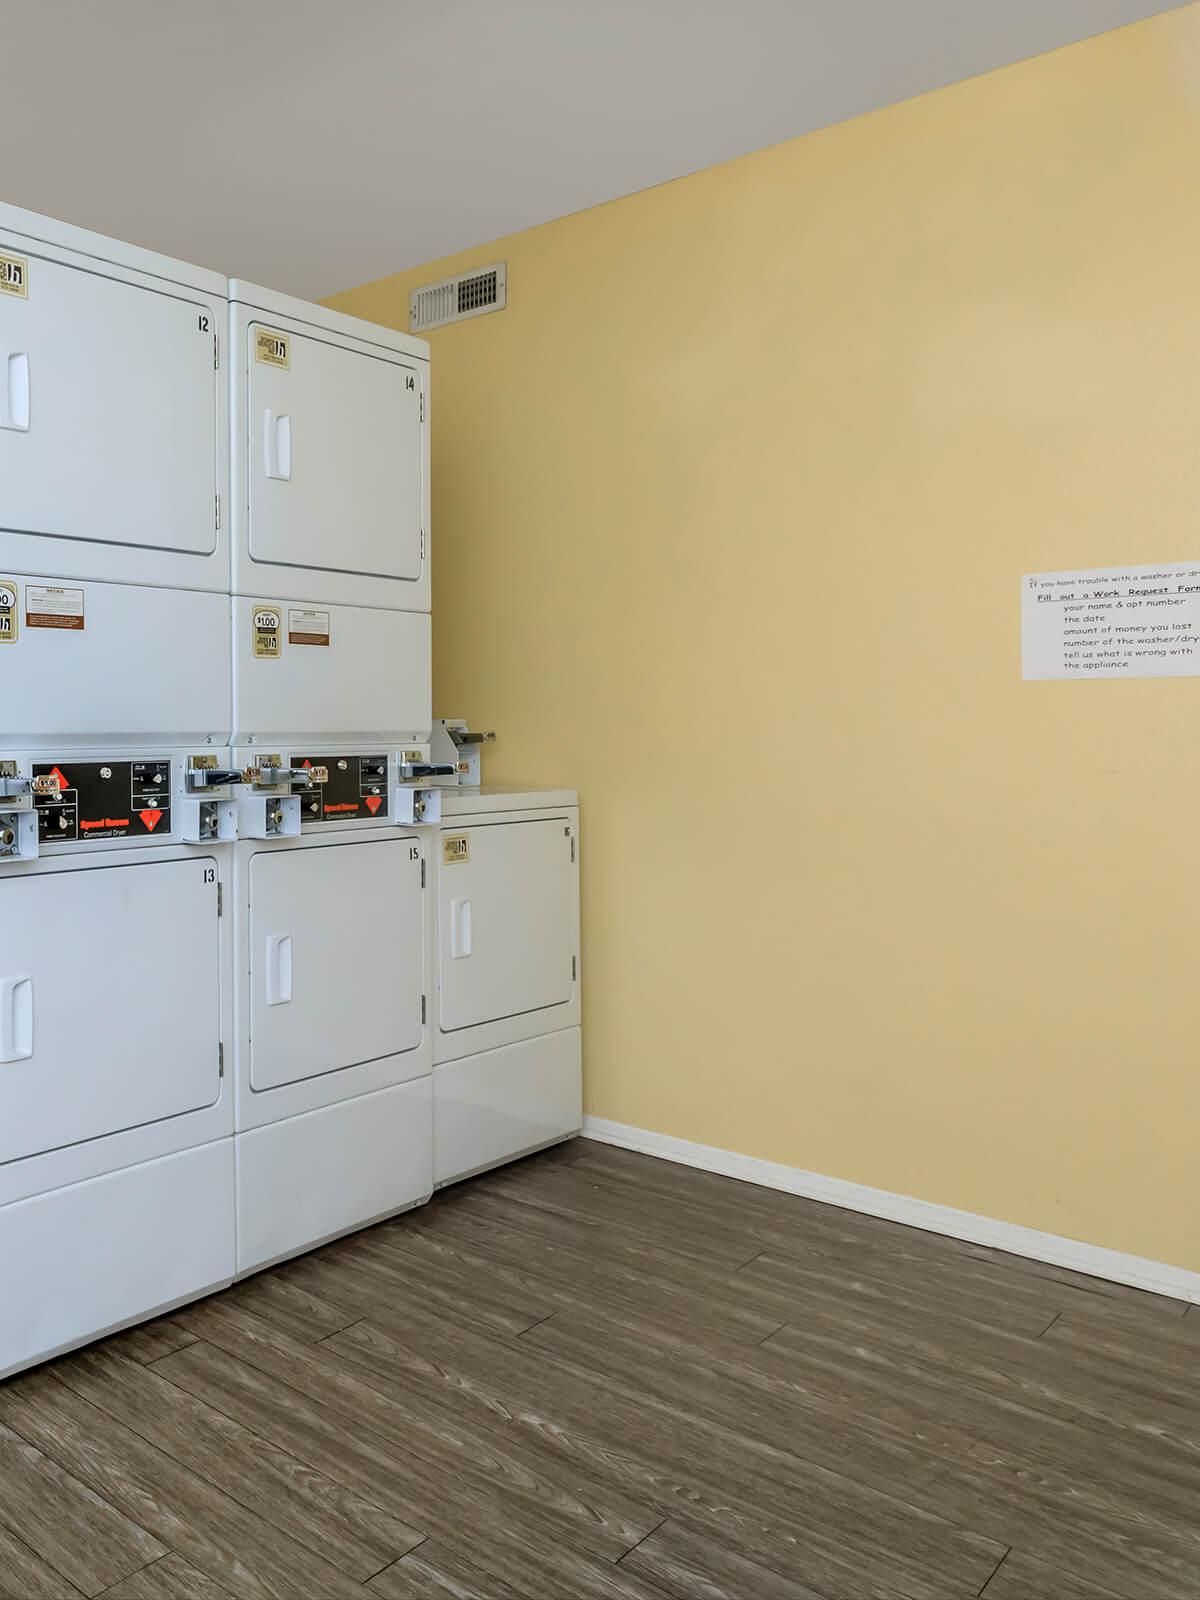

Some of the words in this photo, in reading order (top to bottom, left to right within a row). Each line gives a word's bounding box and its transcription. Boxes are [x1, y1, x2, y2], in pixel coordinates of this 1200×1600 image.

[199, 315, 209, 332] 12
[406, 375, 415, 391] 14
[1029, 581, 1037, 589] If
[1079, 576, 1108, 585] trouble
[1140, 572, 1173, 581] washer
[1094, 590, 1120, 598] Work
[1128, 587, 1169, 596] Request
[1127, 600, 1143, 609] apt
[1146, 598, 1187, 607] number
[1083, 615, 1105, 623] date
[1064, 627, 1098, 635] amount
[1115, 626, 1147, 634] money
[1064, 639, 1100, 647] number
[1117, 637, 1135, 645] the
[1137, 635, 1200, 645] washer/dry
[1064, 651, 1080, 659] tell
[1135, 650, 1167, 658] wrong
[1083, 661, 1129, 669] appliance
[409, 847, 419, 861] 15
[204, 868, 215, 884] 13
